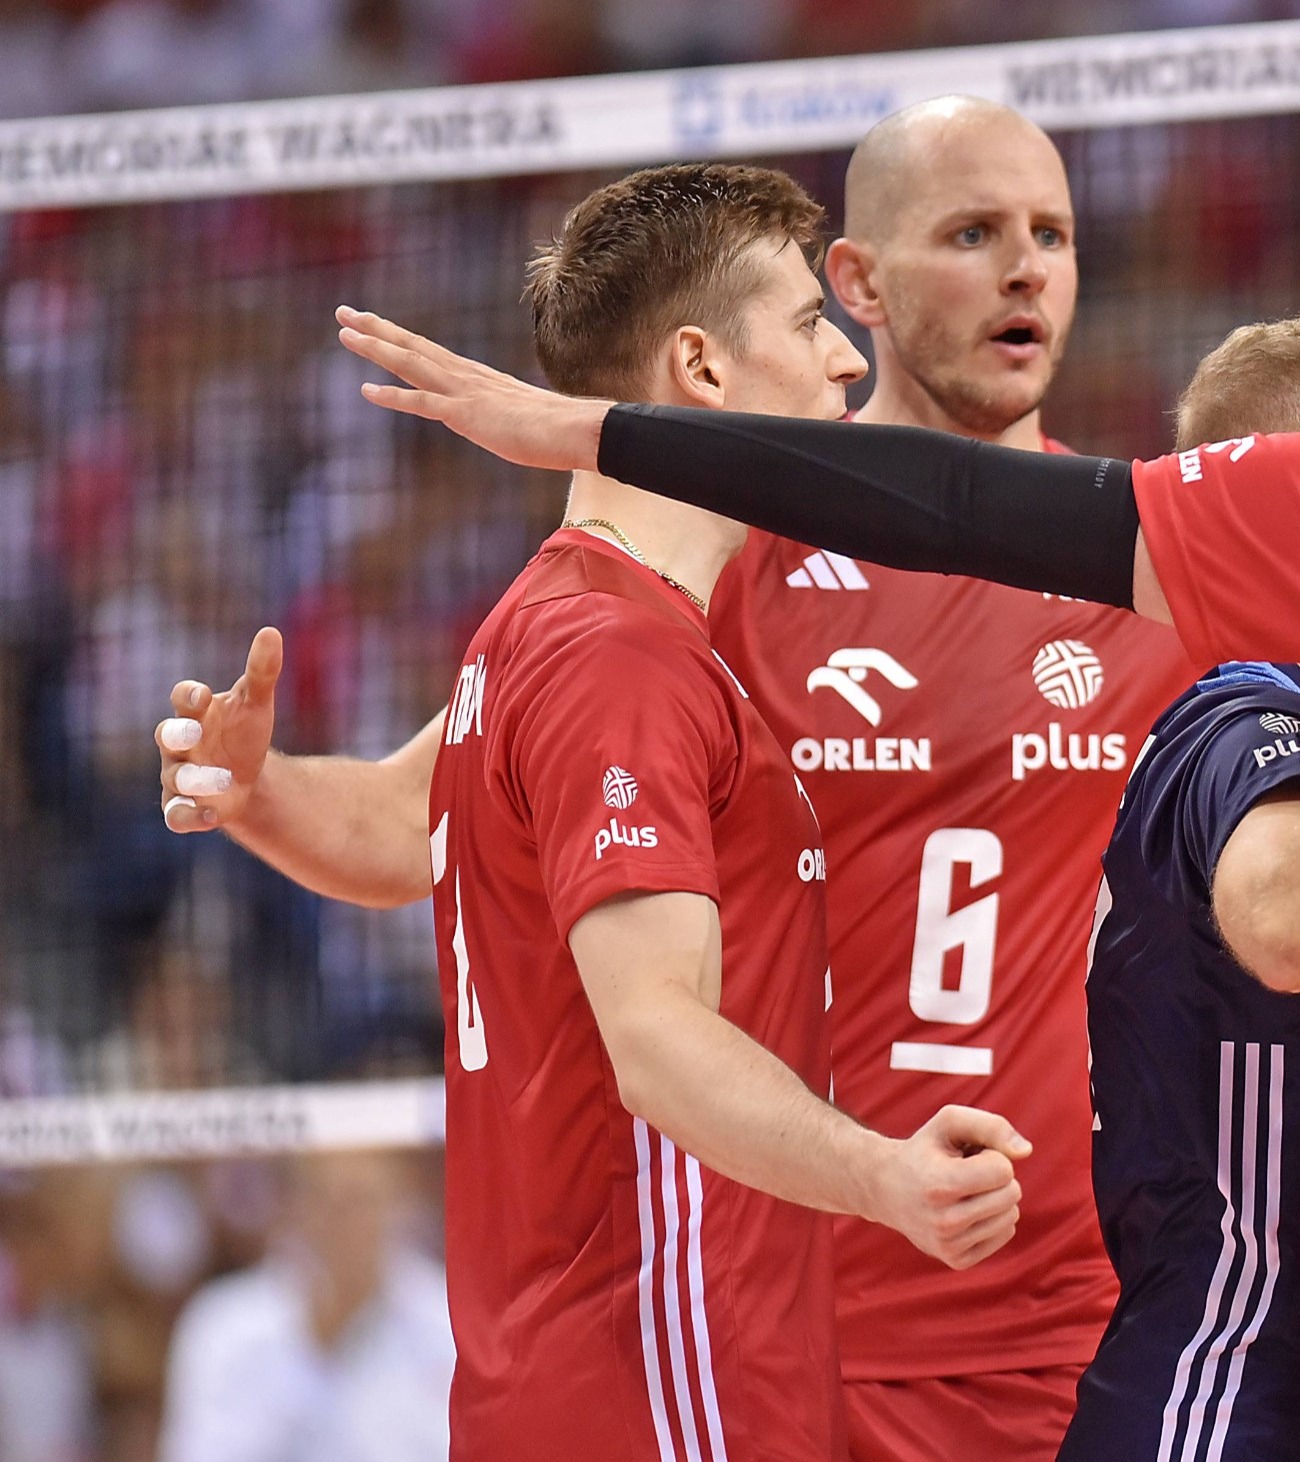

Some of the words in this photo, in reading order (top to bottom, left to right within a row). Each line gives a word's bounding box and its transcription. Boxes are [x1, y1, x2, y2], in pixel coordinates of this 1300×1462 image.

[791, 737, 932, 772] ORLEN
[1011, 722, 1127, 781] plus
[594, 817, 659, 861] plus
[908, 827, 1004, 1026] 6
